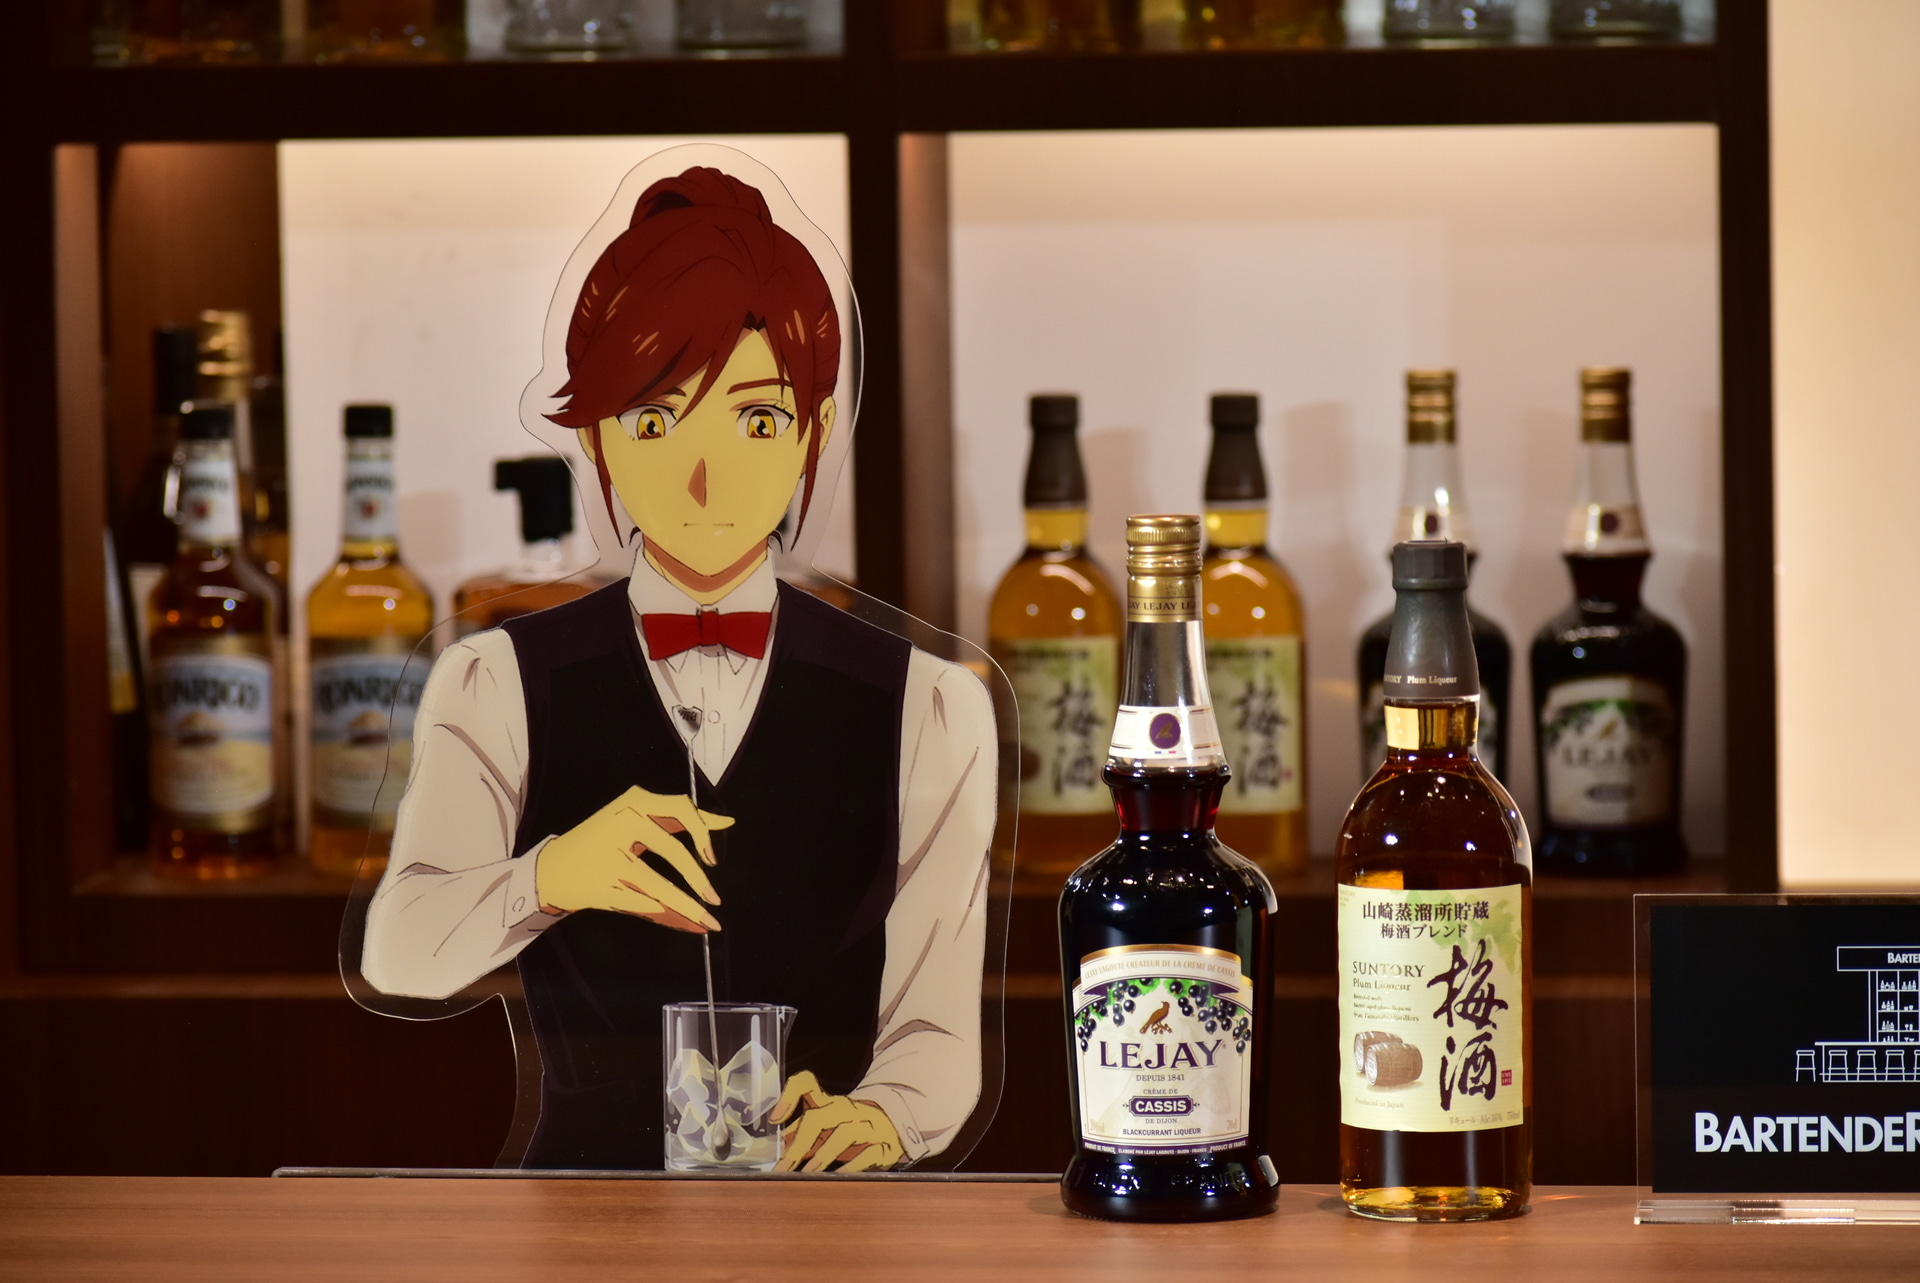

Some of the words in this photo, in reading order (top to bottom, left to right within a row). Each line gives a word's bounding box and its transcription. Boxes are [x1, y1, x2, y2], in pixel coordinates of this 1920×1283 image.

[1144, 602, 1177, 610] LEJAY
[1407, 675, 1427, 684] Plum
[1429, 675, 1457, 685] Liqueur
[1363, 901, 1489, 921] 山崎蒸溜所貯蔵
[1381, 923, 1467, 939] 梅酒ブレンド
[1888, 952, 1920, 964] BARTE
[1217, 967, 1236, 977] CASSIS
[1353, 961, 1426, 977] SUNTORY
[1353, 978, 1371, 989] Plum
[1375, 981, 1411, 992] Liqueur
[1426, 938, 1508, 1111] 梅酒
[1100, 1039, 1223, 1069] LEJAY
[1135, 1100, 1187, 1112] CASSIS
[1387, 1101, 1404, 1109] Japan
[1174, 1128, 1201, 1136] LIQUEUR
